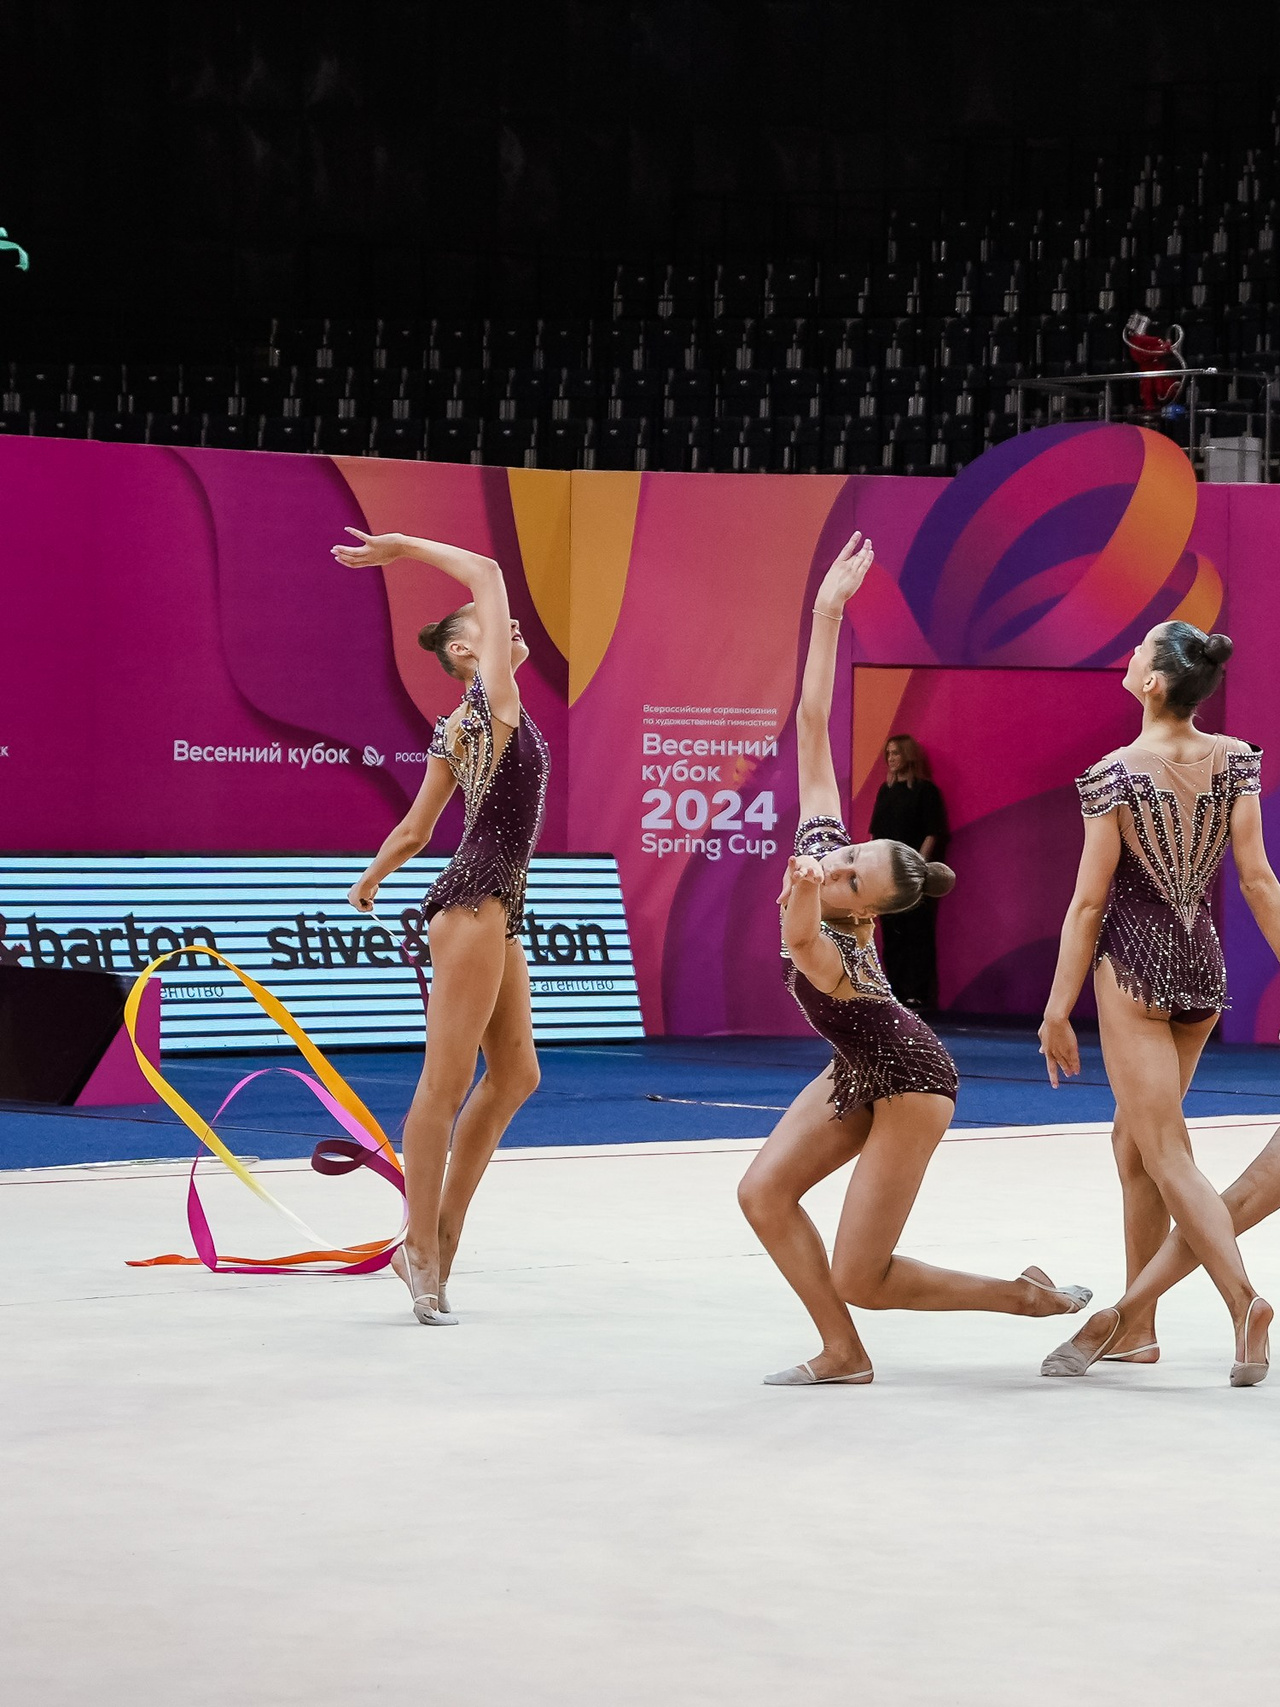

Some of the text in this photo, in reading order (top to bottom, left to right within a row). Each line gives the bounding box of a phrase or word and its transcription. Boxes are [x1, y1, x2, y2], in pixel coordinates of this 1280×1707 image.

[643, 704, 777, 715] Всероссийские соревнования
[655, 718, 725, 726] художественной
[173, 739, 351, 769] Весенний кубок
[642, 732, 777, 757] Весенний
[641, 759, 721, 787] кубок
[641, 788, 778, 831] 2024
[641, 833, 777, 861] Spring Cup
[266, 908, 610, 966] stive&ton
[160, 986, 225, 999] ентство
[541, 980, 615, 993] агентство
